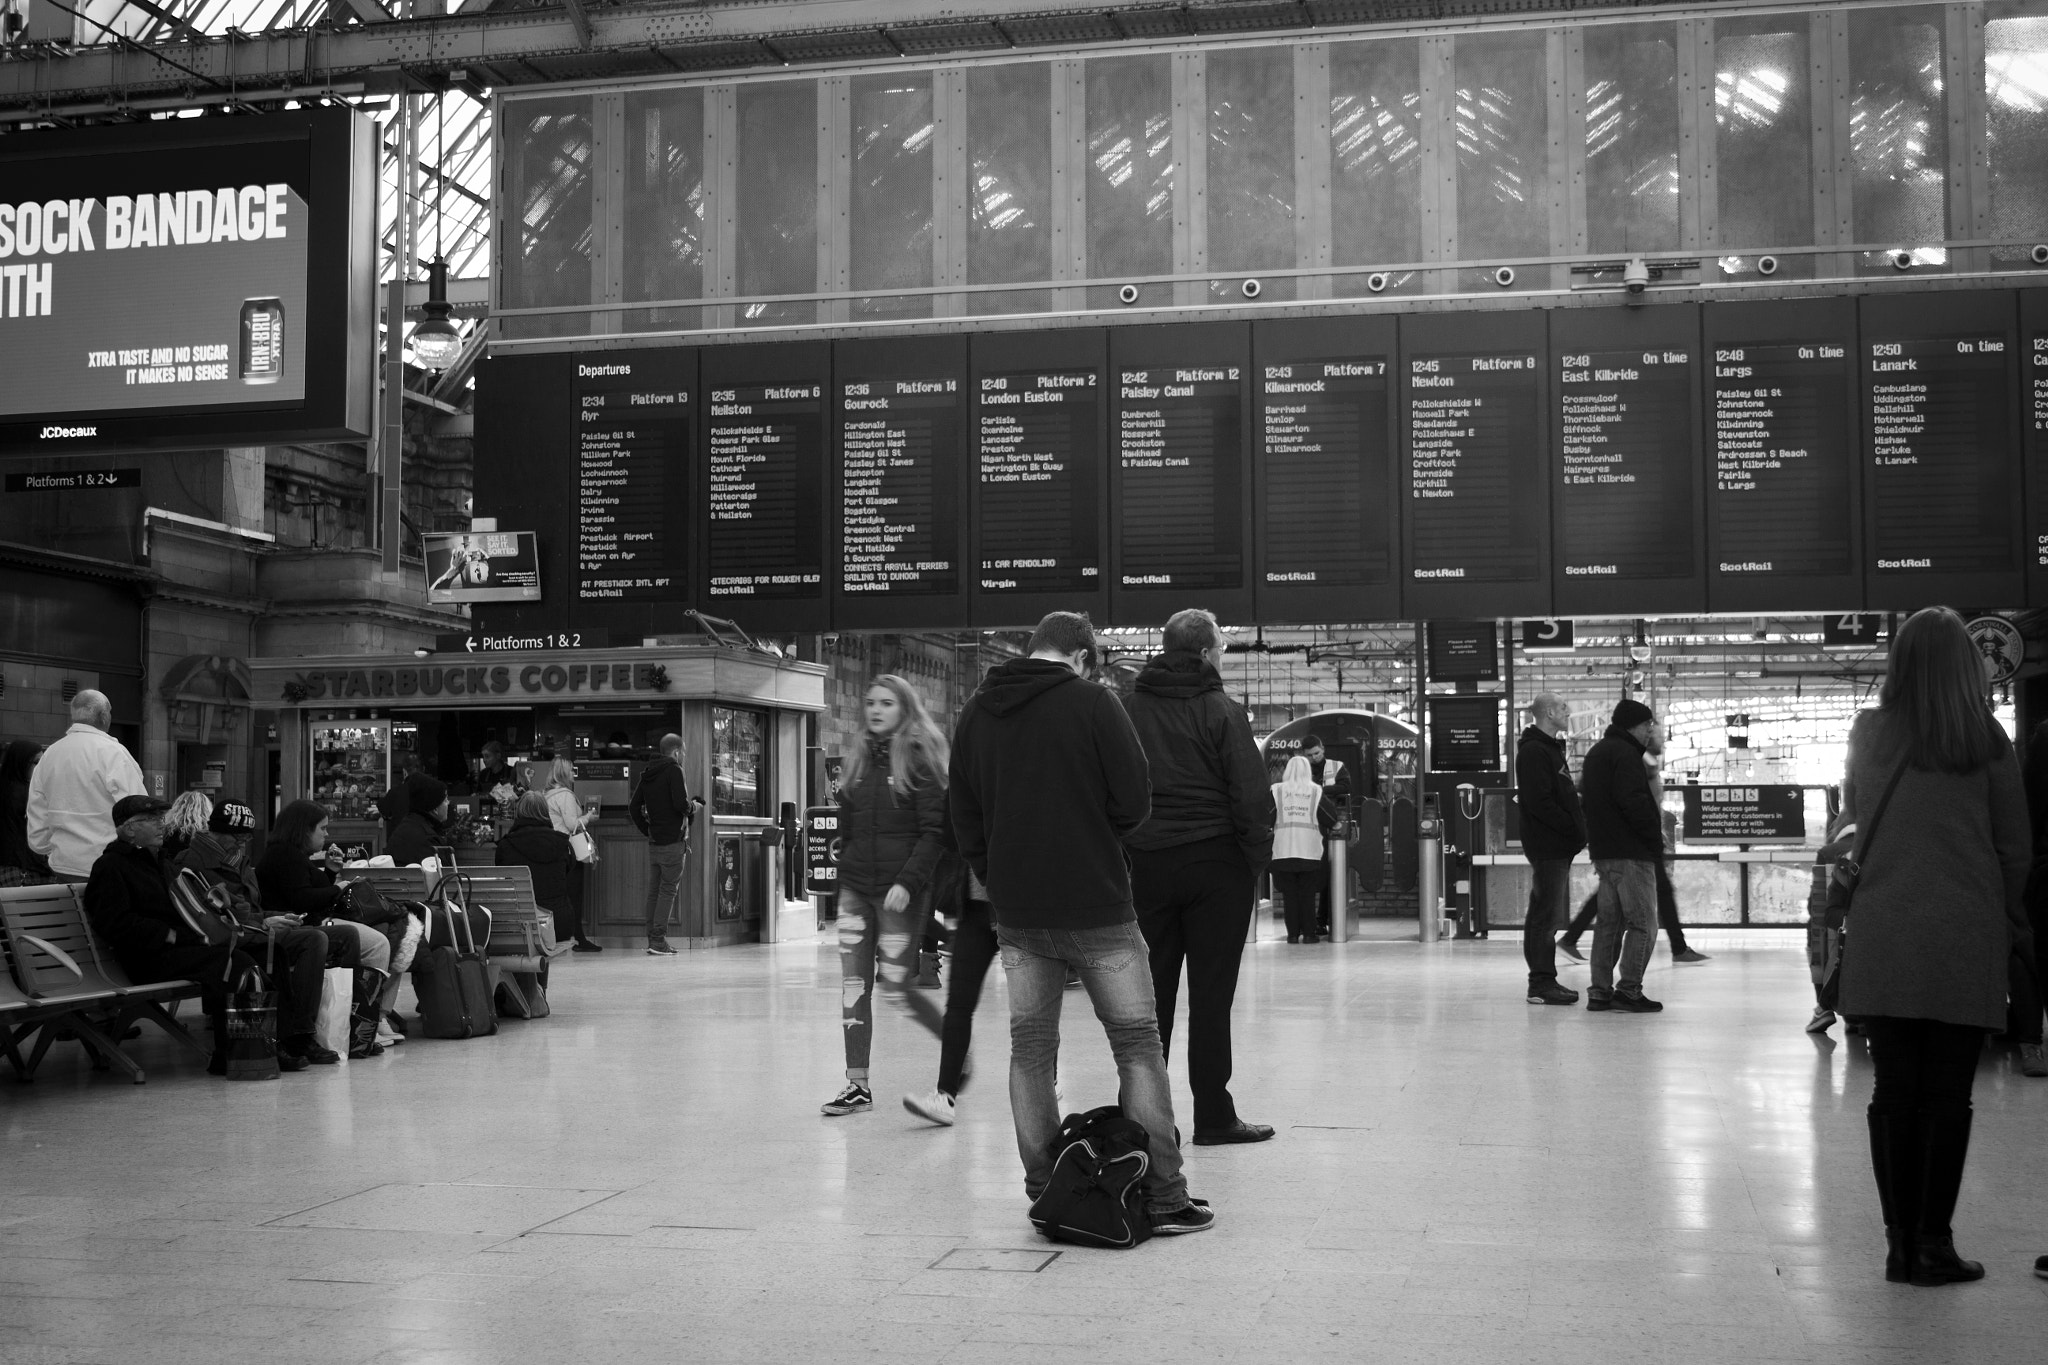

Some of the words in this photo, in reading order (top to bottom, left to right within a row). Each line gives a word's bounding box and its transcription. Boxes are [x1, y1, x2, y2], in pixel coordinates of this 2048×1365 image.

[106, 183, 287, 249] BANDAGE
[272, 322, 281, 358] XTRA
[1873, 344, 1901, 356] 12:50
[1957, 341, 1973, 352] On
[1979, 341, 2004, 351] time
[88, 351, 116, 367] XTRA
[118, 349, 149, 366] TASTE
[151, 348, 173, 365] AND
[175, 347, 190, 363] NO
[192, 344, 228, 362] SUGAR
[1716, 350, 1743, 361] 12:48
[1799, 348, 1813, 358] On
[1819, 347, 1844, 358] time
[1562, 356, 1590, 367] 12:48
[1643, 354, 1658, 364] On
[1663, 352, 1687, 363] time
[1412, 361, 1439, 372] 12:45
[1473, 359, 1521, 371] Platform
[1527, 358, 1535, 369] 8
[1873, 359, 1917, 371] Lanark
[126, 370, 136, 385] IT
[138, 367, 175, 384] MAKES
[177, 366, 193, 382] NO
[195, 364, 228, 381] SENSE
[579, 365, 630, 378] Departures
[1265, 367, 1292, 378] 12:43
[1324, 365, 1372, 376] Platform
[1378, 363, 1385, 374] 7
[1716, 366, 1752, 378] Largs
[1122, 372, 1147, 383] 12:42
[1176, 370, 1224, 382] Platform
[1229, 369, 1239, 379] 12
[1562, 371, 1590, 382] East
[1595, 369, 1638, 381] Kilbride
[982, 379, 1007, 390] 12:40
[1038, 377, 1084, 388] Platform
[1089, 375, 1096, 385] 2
[1412, 376, 1453, 387] Newton
[845, 385, 869, 395] 12:36
[897, 383, 942, 394] Platform
[946, 381, 956, 391] 14
[1265, 381, 1325, 393] Kilmarnock
[1874, 385, 1926, 394] Cambuslang
[711, 391, 735, 401] 12:35
[765, 389, 808, 399] Platform
[813, 387, 820, 397] 6
[1122, 387, 1160, 398] Paisley
[1164, 386, 1194, 396] Canal
[582, 396, 604, 406] 12:34
[631, 393, 673, 404] Platform
[678, 393, 687, 402] 13
[981, 394, 1020, 404] London
[1025, 392, 1063, 402] Euston
[1874, 395, 1926, 403] Uddingston
[845, 399, 888, 410] Gourock
[1717, 400, 1764, 408] Johnstone
[711, 405, 751, 416] Neilston
[1266, 406, 1306, 414] Barrhead
[1874, 405, 1914, 413] Bellshill
[582, 411, 599, 422] Ayr
[1563, 415, 1621, 423] Thornliebank
[1717, 410, 1773, 419] Glengarnock
[1874, 415, 1924, 423] Motherwell
[1122, 420, 1165, 428] Corkerhill
[1266, 416, 1294, 424] Dunlop
[1413, 420, 1457, 428] Shawlands
[1266, 425, 1309, 433] Stewarton
[1717, 421, 1763, 429] Kilwinning
[40, 426, 97, 439] JCDecaux
[1122, 430, 1161, 438] Mosspark
[1718, 431, 1769, 439] Stevenston
[1122, 440, 1165, 448] Crookston
[1413, 440, 1452, 448] Langside
[1564, 436, 1607, 444] Clarkston
[1413, 450, 1437, 458] Kings
[1441, 449, 1461, 457] Park
[1875, 446, 1911, 454] Carluke
[1564, 455, 1622, 463] Thorntonhall
[1413, 460, 1456, 468] Croftfoot
[1413, 470, 1453, 478] Burnside
[26, 475, 74, 488] Platforms
[77, 475, 82, 485] 1
[86, 474, 95, 485] &
[98, 473, 104, 484] 2
[1720, 562, 1772, 571] ScotRail
[1878, 559, 1931, 568] ScotRail
[1415, 569, 1464, 578] ScotRail
[1566, 566, 1616, 574] ScotRail
[1123, 576, 1170, 584] ScotRail
[1267, 573, 1315, 581] ScotRail
[844, 583, 889, 591] ScotRail
[982, 580, 1016, 588] Virgin
[483, 636, 543, 650] Platforms
[547, 635, 553, 648] 1
[558, 634, 569, 647] &
[573, 633, 580, 647] 2
[307, 666, 510, 698] STARBUCKS
[520, 663, 651, 692] COFFEE
[1270, 740, 1287, 749] 350
[1378, 739, 1396, 749] 350
[1397, 739, 1417, 748] 404
[812, 853, 824, 861] gate
